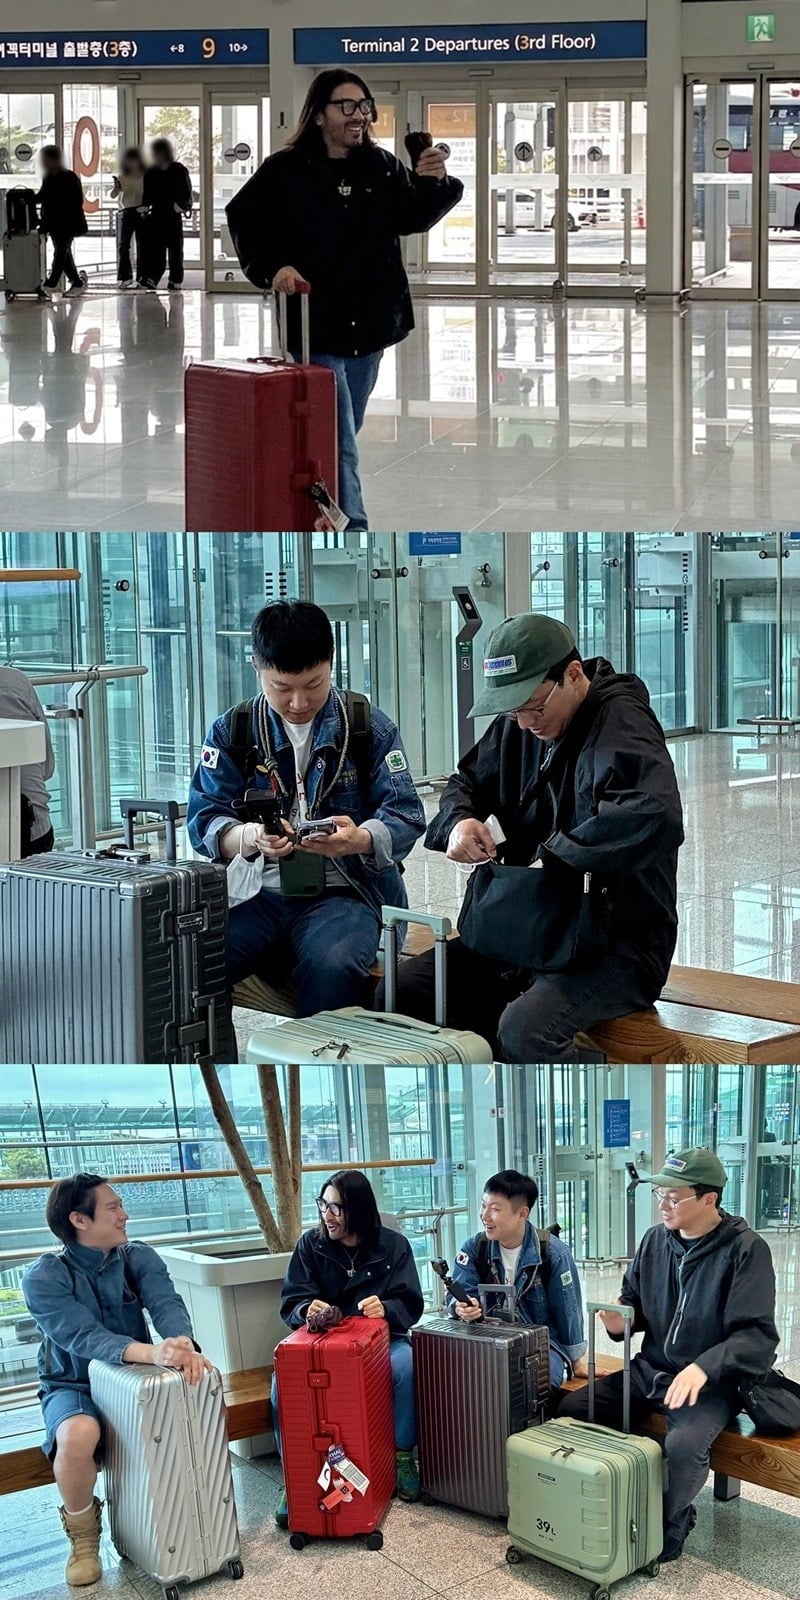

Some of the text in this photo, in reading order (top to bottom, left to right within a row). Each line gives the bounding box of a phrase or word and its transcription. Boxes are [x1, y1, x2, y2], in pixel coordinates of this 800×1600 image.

[200, 37, 217, 59] 9
[341, 32, 596, 55] Terminal 2 Departures (3rd Floor)
